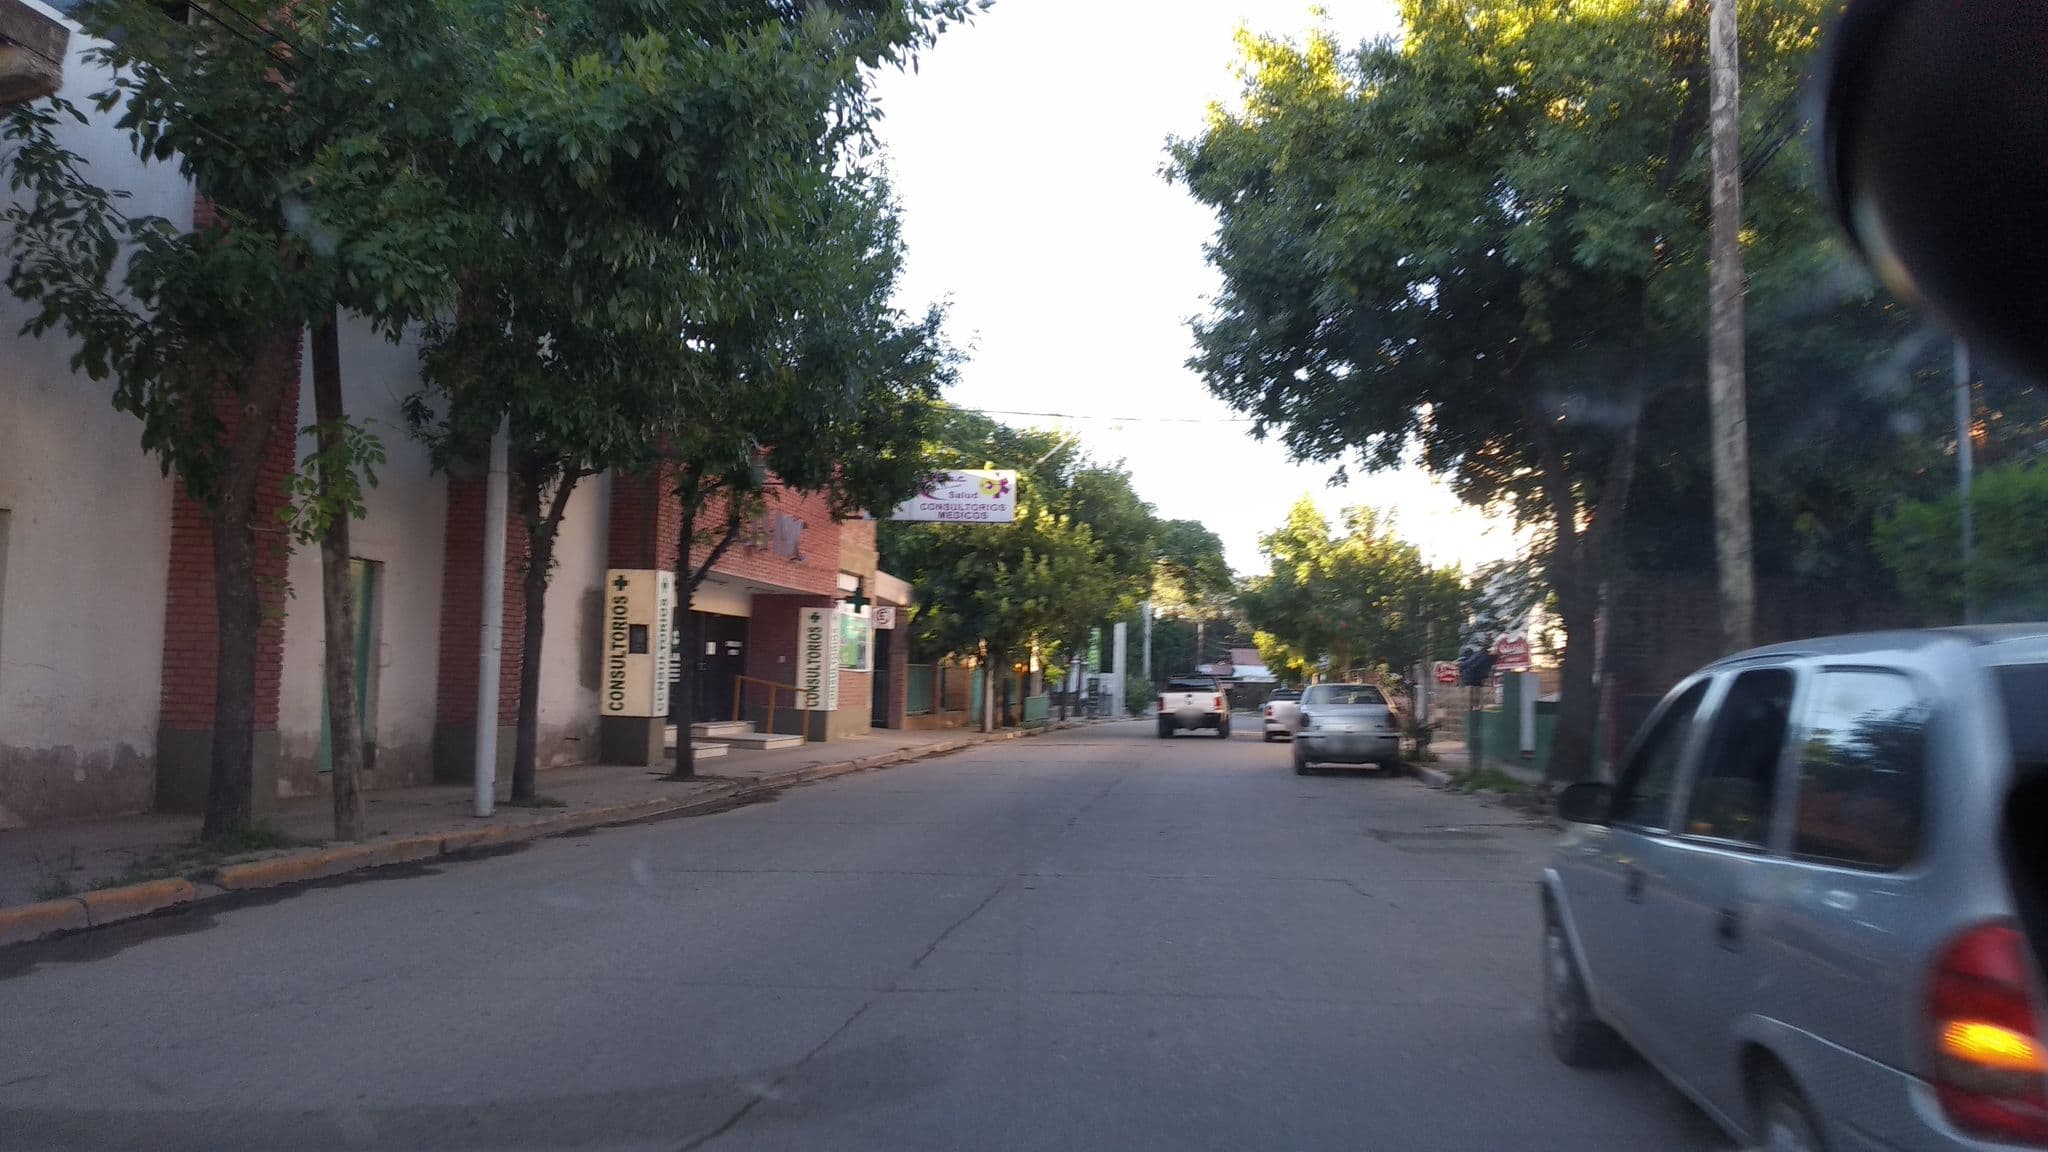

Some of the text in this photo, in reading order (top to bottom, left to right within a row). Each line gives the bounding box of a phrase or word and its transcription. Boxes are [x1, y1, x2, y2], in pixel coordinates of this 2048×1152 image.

[920, 503, 1007, 512] CONSULTORIOS
[948, 491, 978, 499] Salud
[609, 596, 629, 711] CONSULTORIOS
[656, 598, 669, 712] CONSULTORIOS
[806, 626, 822, 707] CONSULTORIOS
